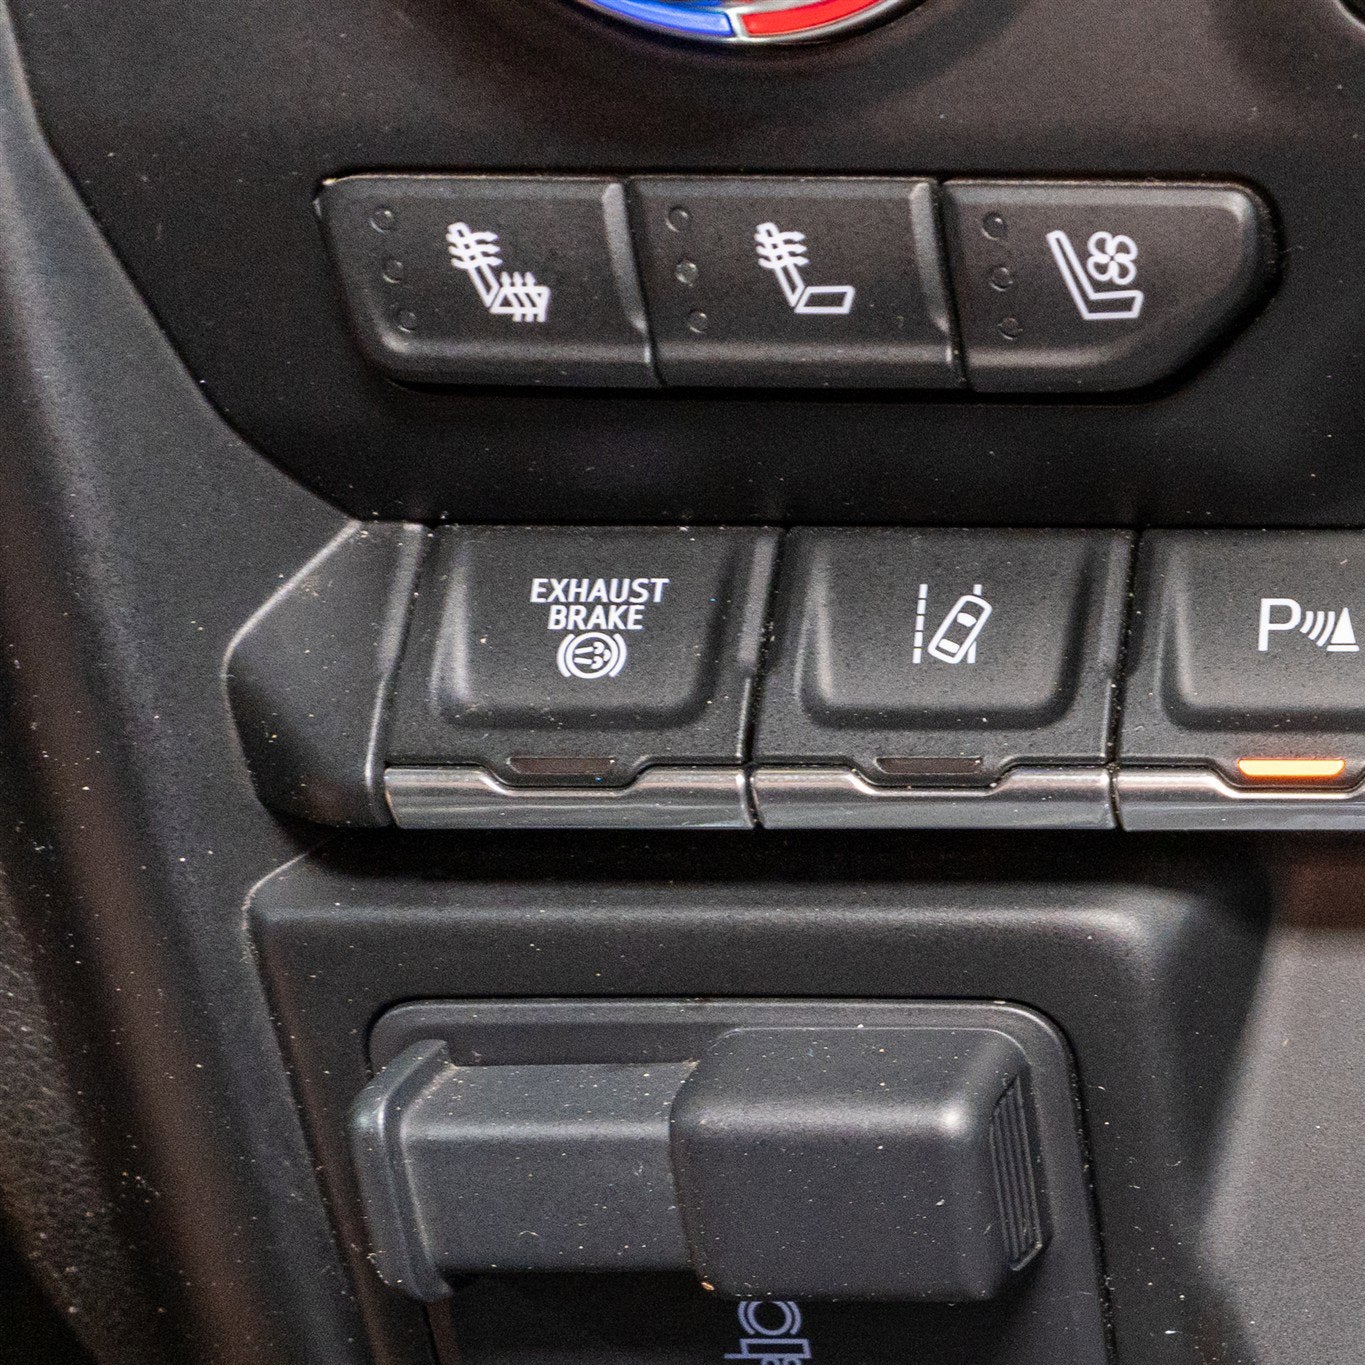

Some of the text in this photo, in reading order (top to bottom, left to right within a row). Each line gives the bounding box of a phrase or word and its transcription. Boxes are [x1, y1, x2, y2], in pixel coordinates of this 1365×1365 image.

[529, 577, 670, 604] EXHAUST
[547, 604, 645, 631] BRAKE
[1257, 597, 1302, 652] P
